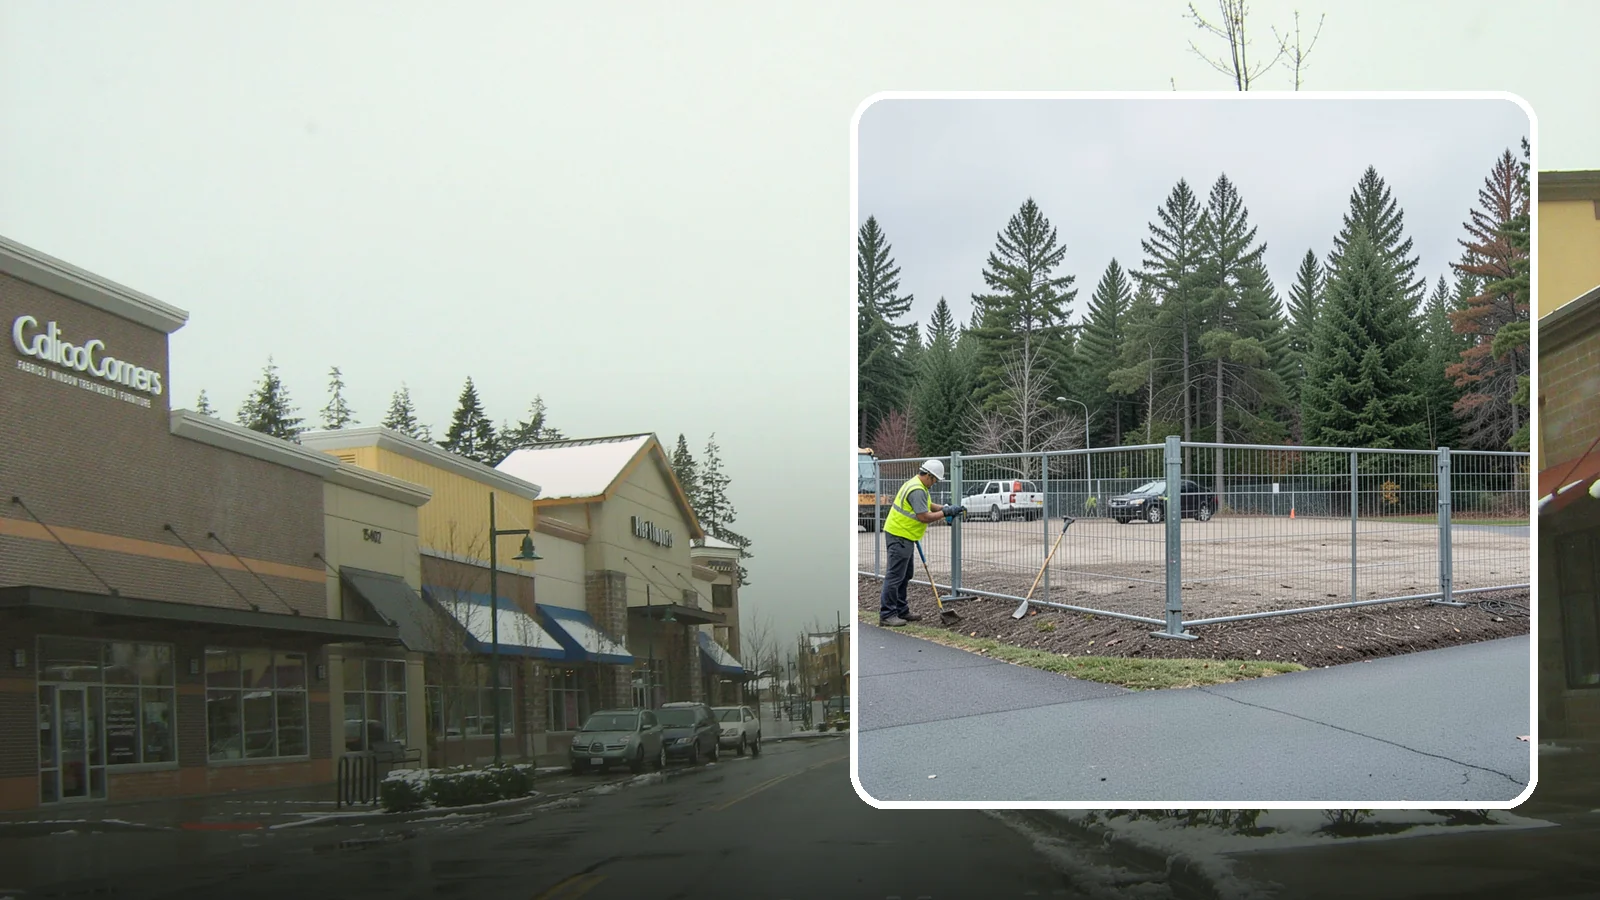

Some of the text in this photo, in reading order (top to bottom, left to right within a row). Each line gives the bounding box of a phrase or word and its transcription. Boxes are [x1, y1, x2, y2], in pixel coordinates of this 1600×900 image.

[16, 360, 151, 409] FABRICS WINDOW TREATMENTS FURNITURE
